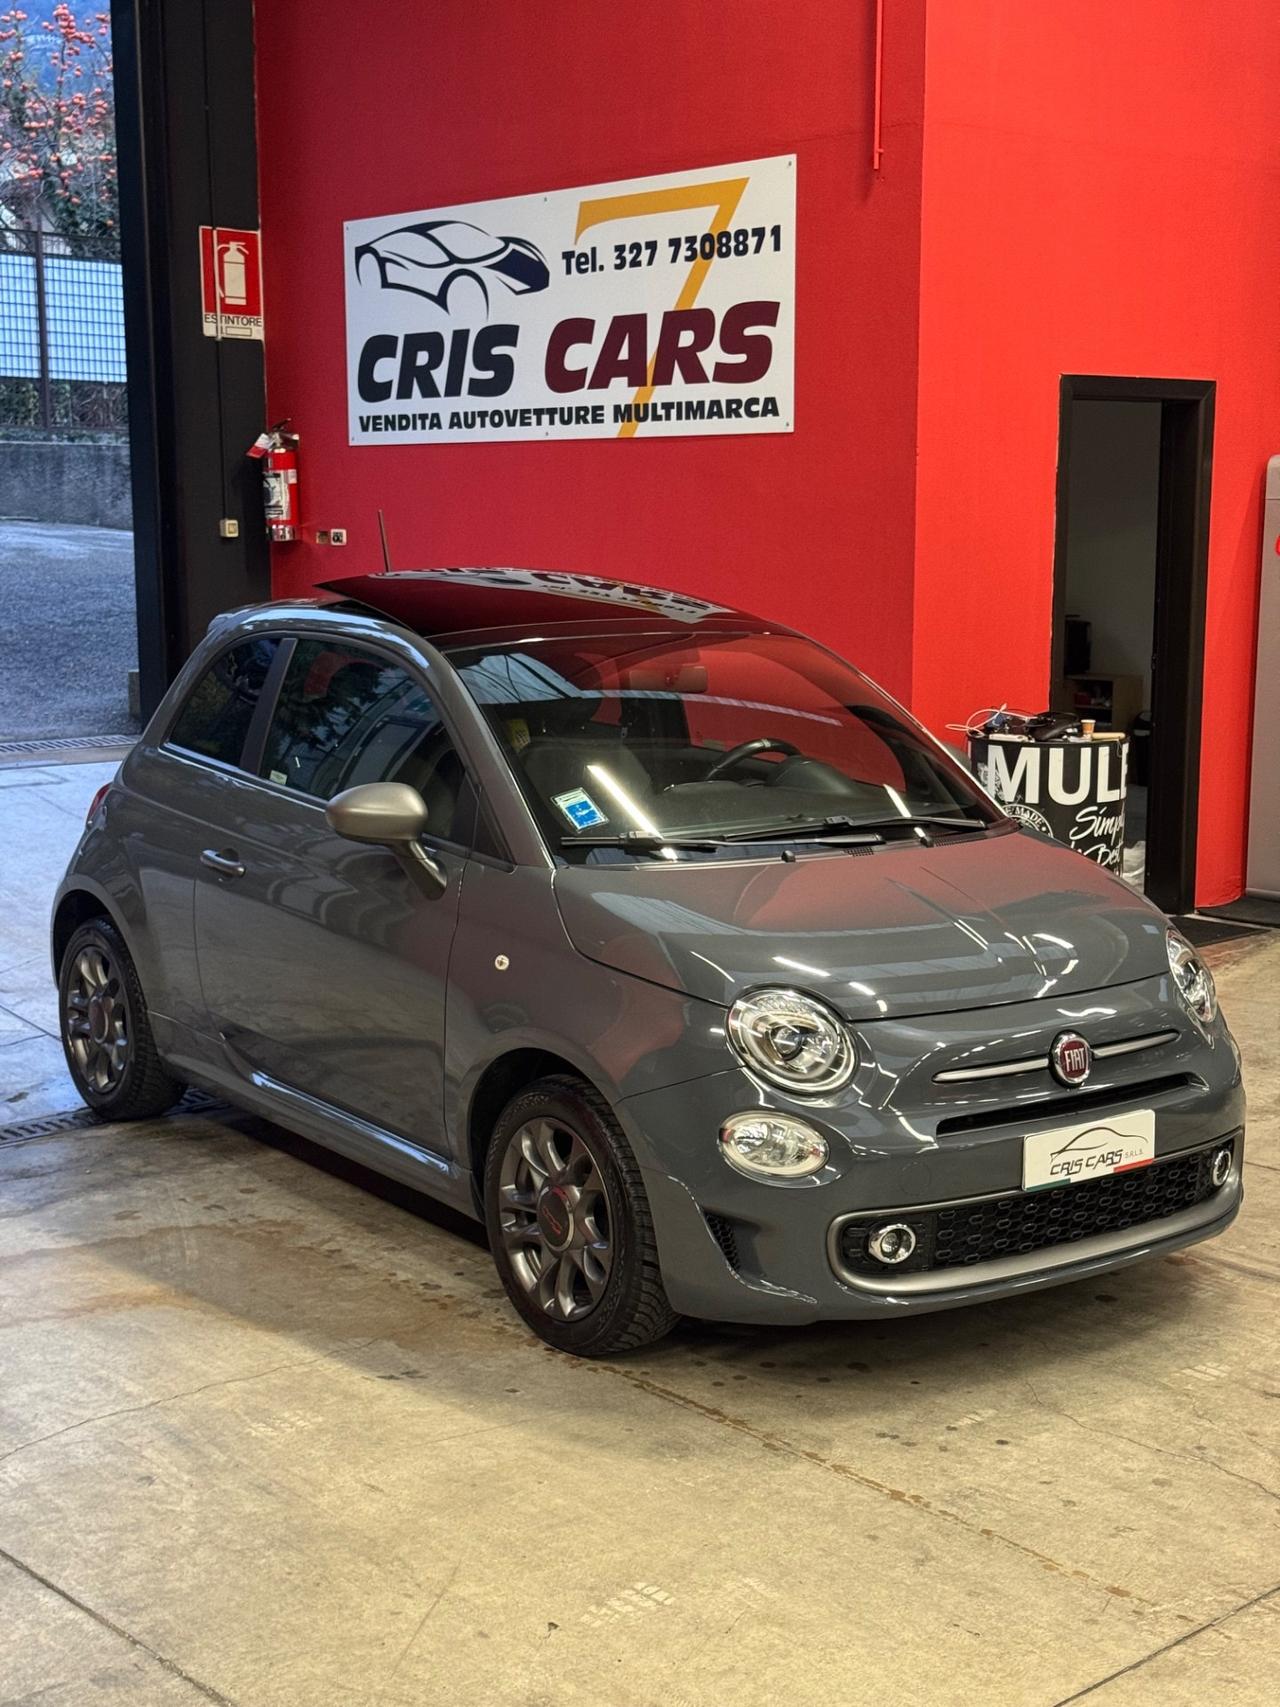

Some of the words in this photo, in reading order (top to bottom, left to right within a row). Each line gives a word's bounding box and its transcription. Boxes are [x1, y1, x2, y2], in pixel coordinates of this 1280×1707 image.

[562, 246, 604, 275] Tel.
[613, 240, 658, 271] 327
[668, 224, 781, 264] 7308871
[204, 313, 262, 327] ESTINTORE
[357, 324, 520, 403] CRIS
[544, 300, 780, 393] CARS
[359, 412, 442, 432] VENDITA
[448, 405, 605, 429] AUTOVETTURE
[613, 397, 780, 423] MULTIMARCA
[1064, 1047, 1085, 1072] FIAT
[1049, 1158, 1083, 1176] CRIS
[1085, 1149, 1123, 1170] CARS
